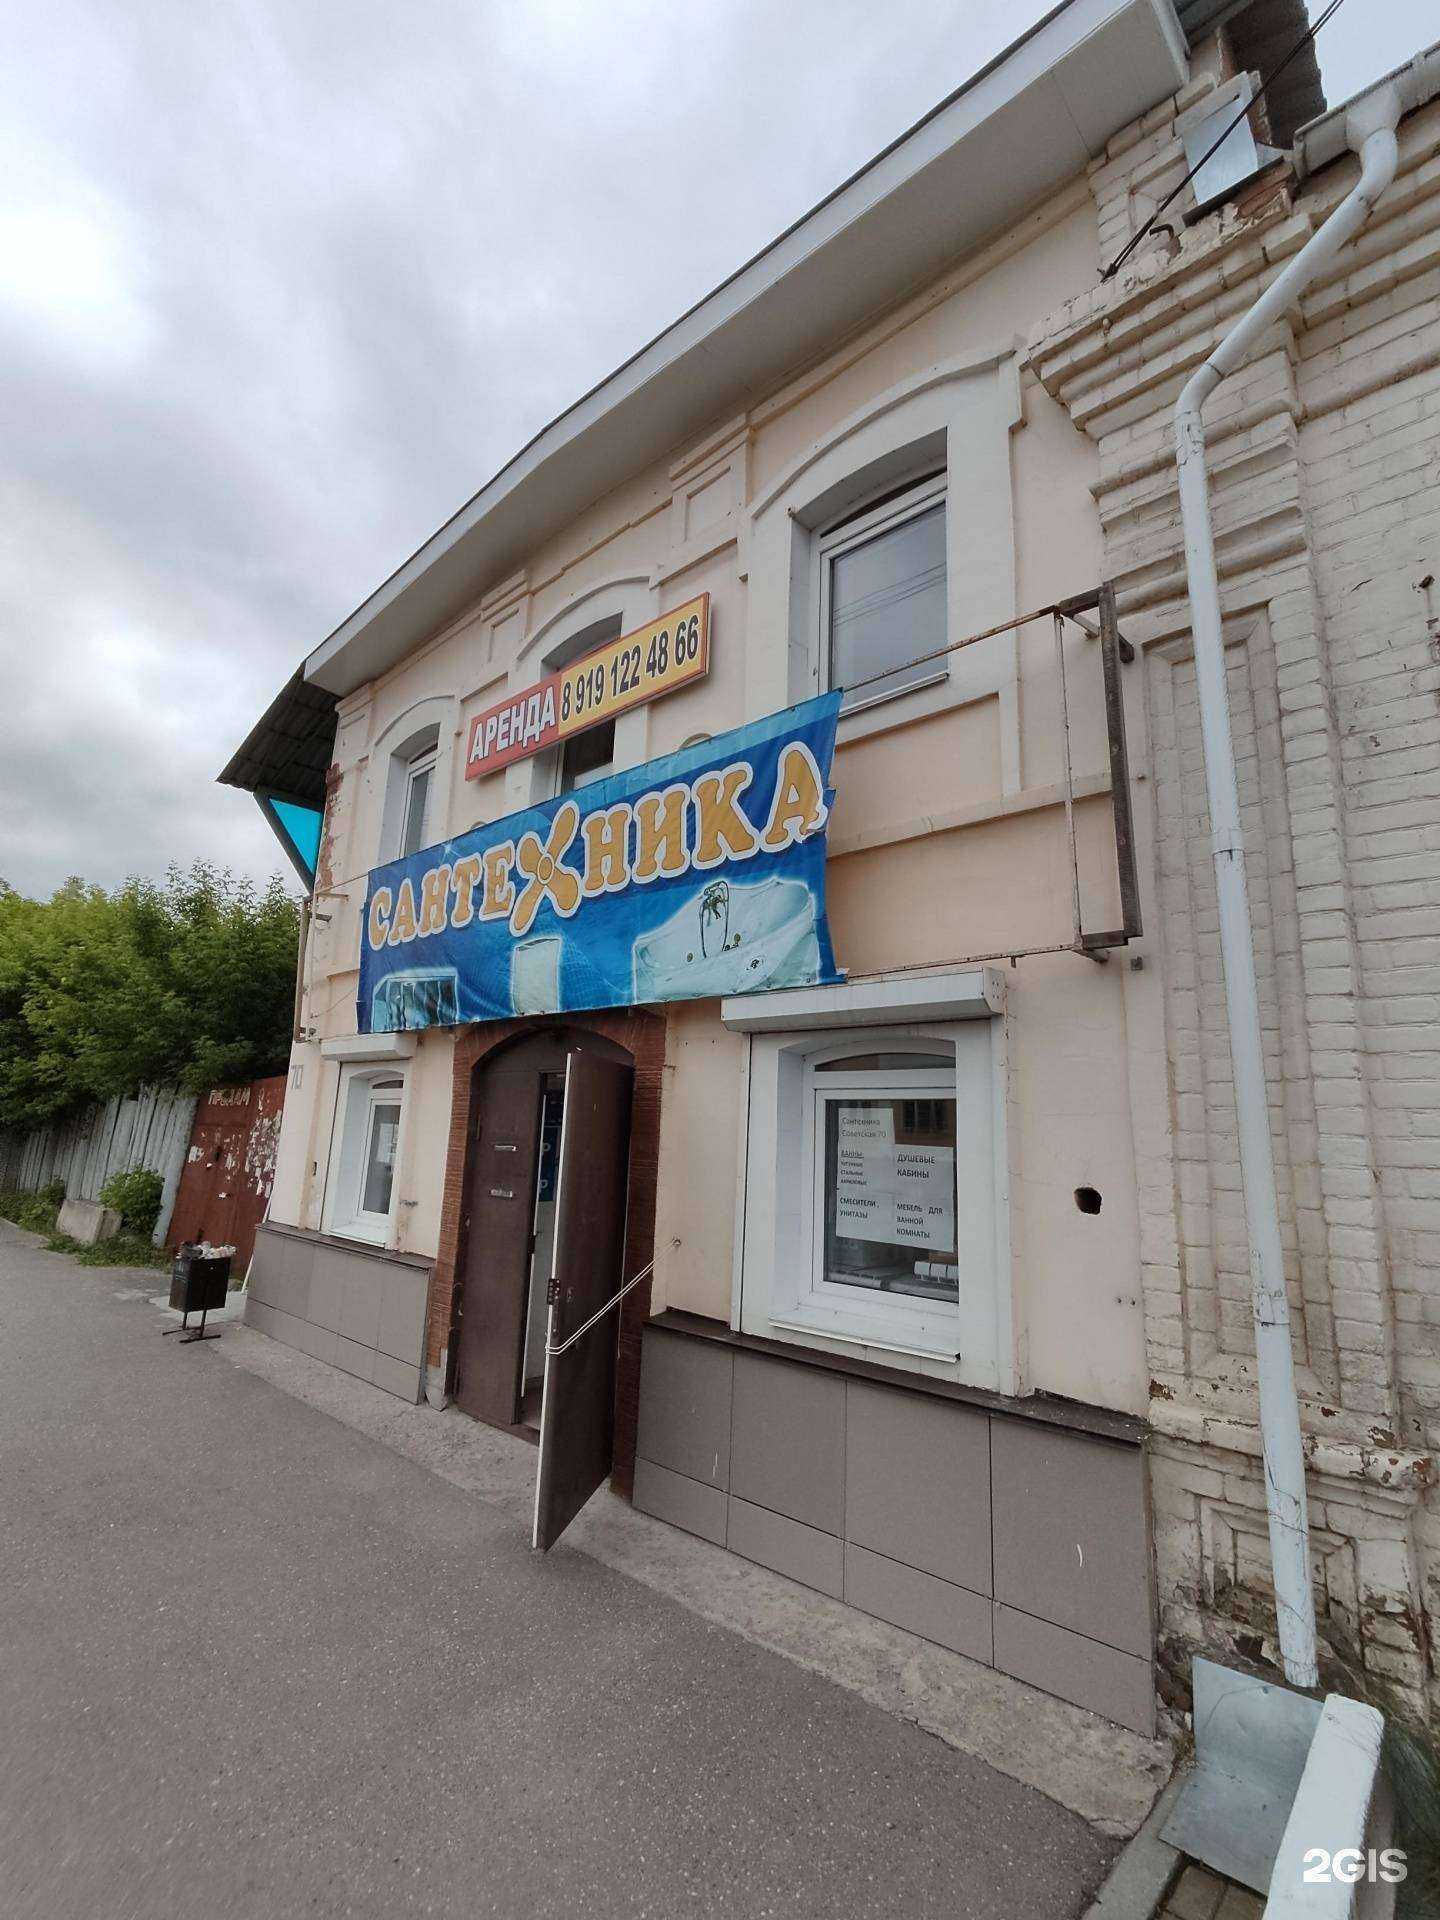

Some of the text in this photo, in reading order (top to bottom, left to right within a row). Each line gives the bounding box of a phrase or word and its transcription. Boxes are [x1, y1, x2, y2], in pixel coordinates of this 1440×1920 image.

[469, 614, 699, 763] АРЕНДА 8 919 122 48 66
[368, 741, 829, 951] САНТЕХНИКА
[897, 1153, 935, 1164] ДУШЕВЫЕ
[897, 1168, 930, 1179] КАБИНЫ
[897, 1203, 943, 1215] МЕБЕЛЬ ДЛЯ
[896, 1215, 924, 1226] ВАННОЙ
[896, 1227, 931, 1239] КОМНАТЫ
